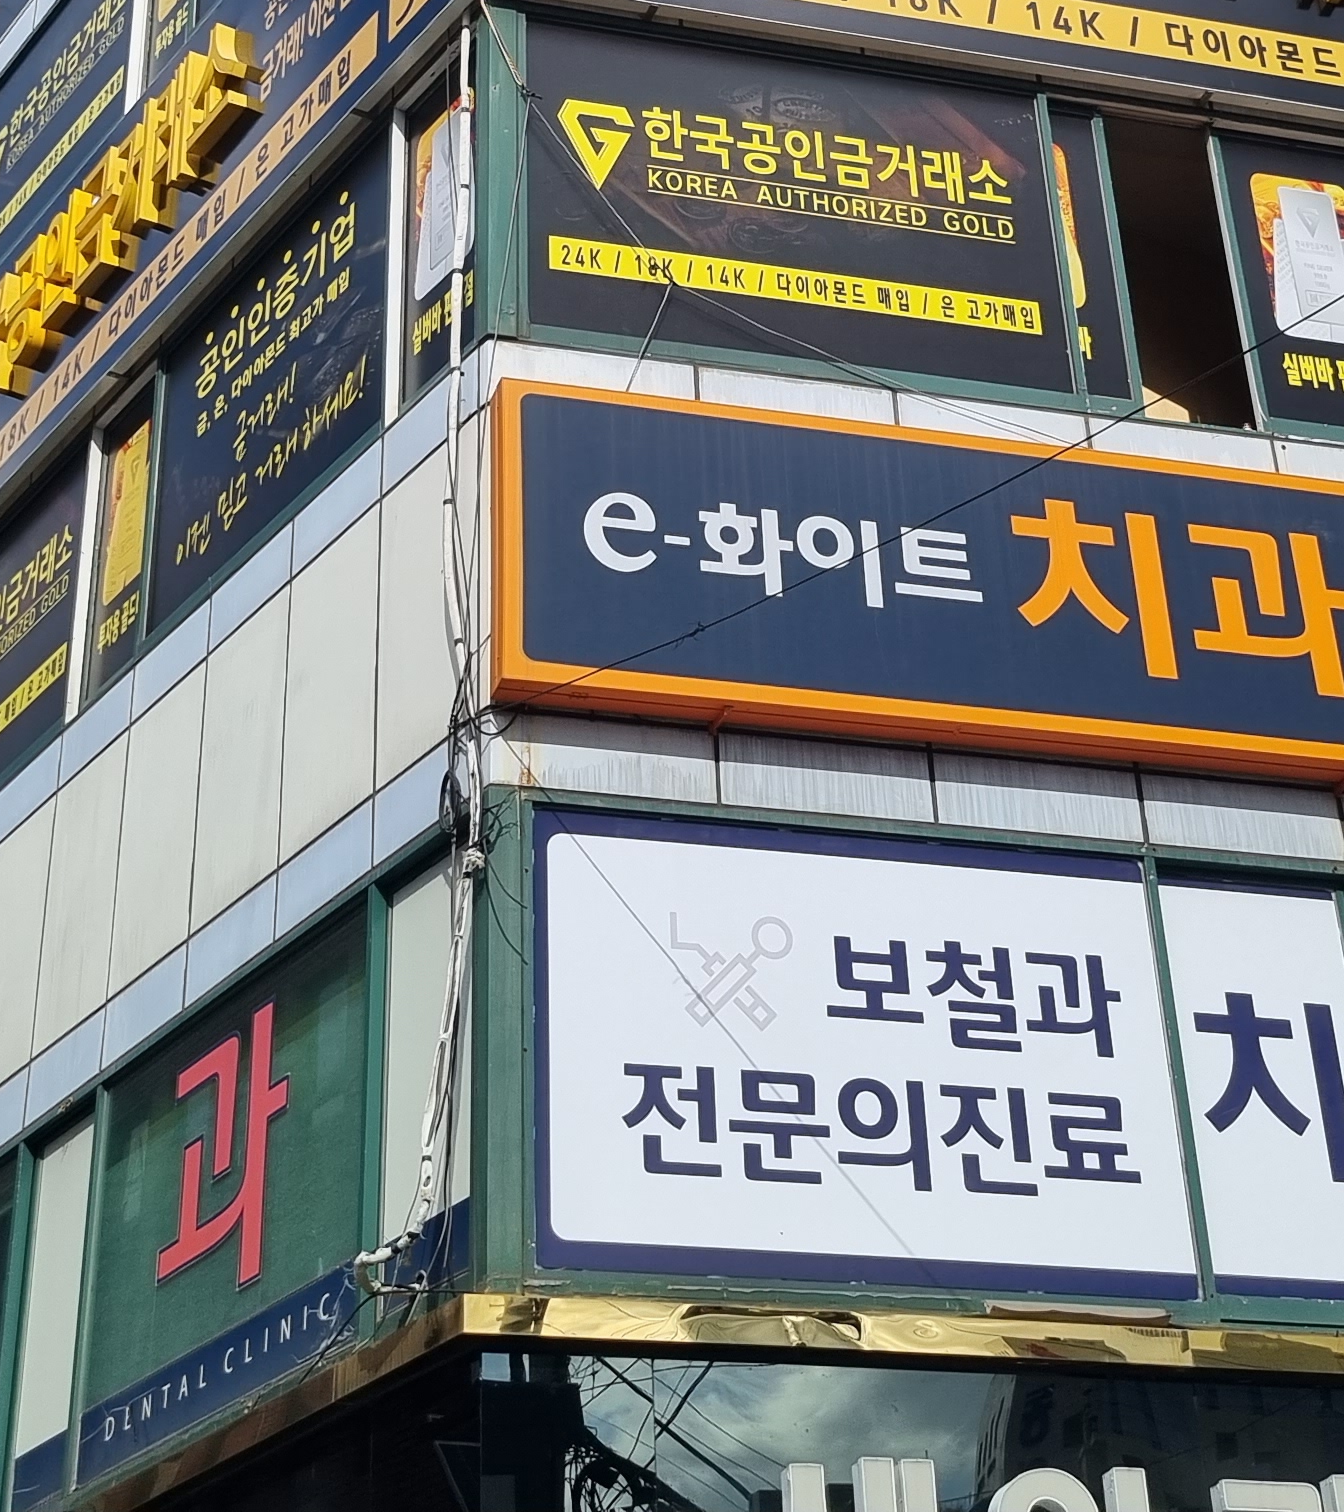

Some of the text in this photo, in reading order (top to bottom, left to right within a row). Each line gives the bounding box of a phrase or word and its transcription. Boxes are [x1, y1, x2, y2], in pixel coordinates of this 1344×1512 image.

[1025, 1, 1105, 41] 14K
[1164, 22, 1341, 78] 다이아몬드
[641, 106, 1013, 205] 한국공인금거래소
[647, 169, 1015, 240] KOREA AUTHORIZED GOLD
[107, 243, 186, 336] 다이아몬드
[195, 201, 356, 400] 공인인증기업
[560, 244, 603, 270] 24K
[706, 263, 746, 289] 14K
[777, 273, 866, 306] 다이아몬드
[877, 287, 910, 312] 매입
[940, 295, 956, 319] 은
[231, 338, 286, 401] 다이아몬드
[1281, 352, 1336, 389] 실버바
[583, 491, 984, 609] e-화이트
[825, 935, 1122, 1059] 보철과
[621, 1062, 1142, 1197] 전문의진료
[104, 1292, 330, 1441] DENTAL CLINIC
